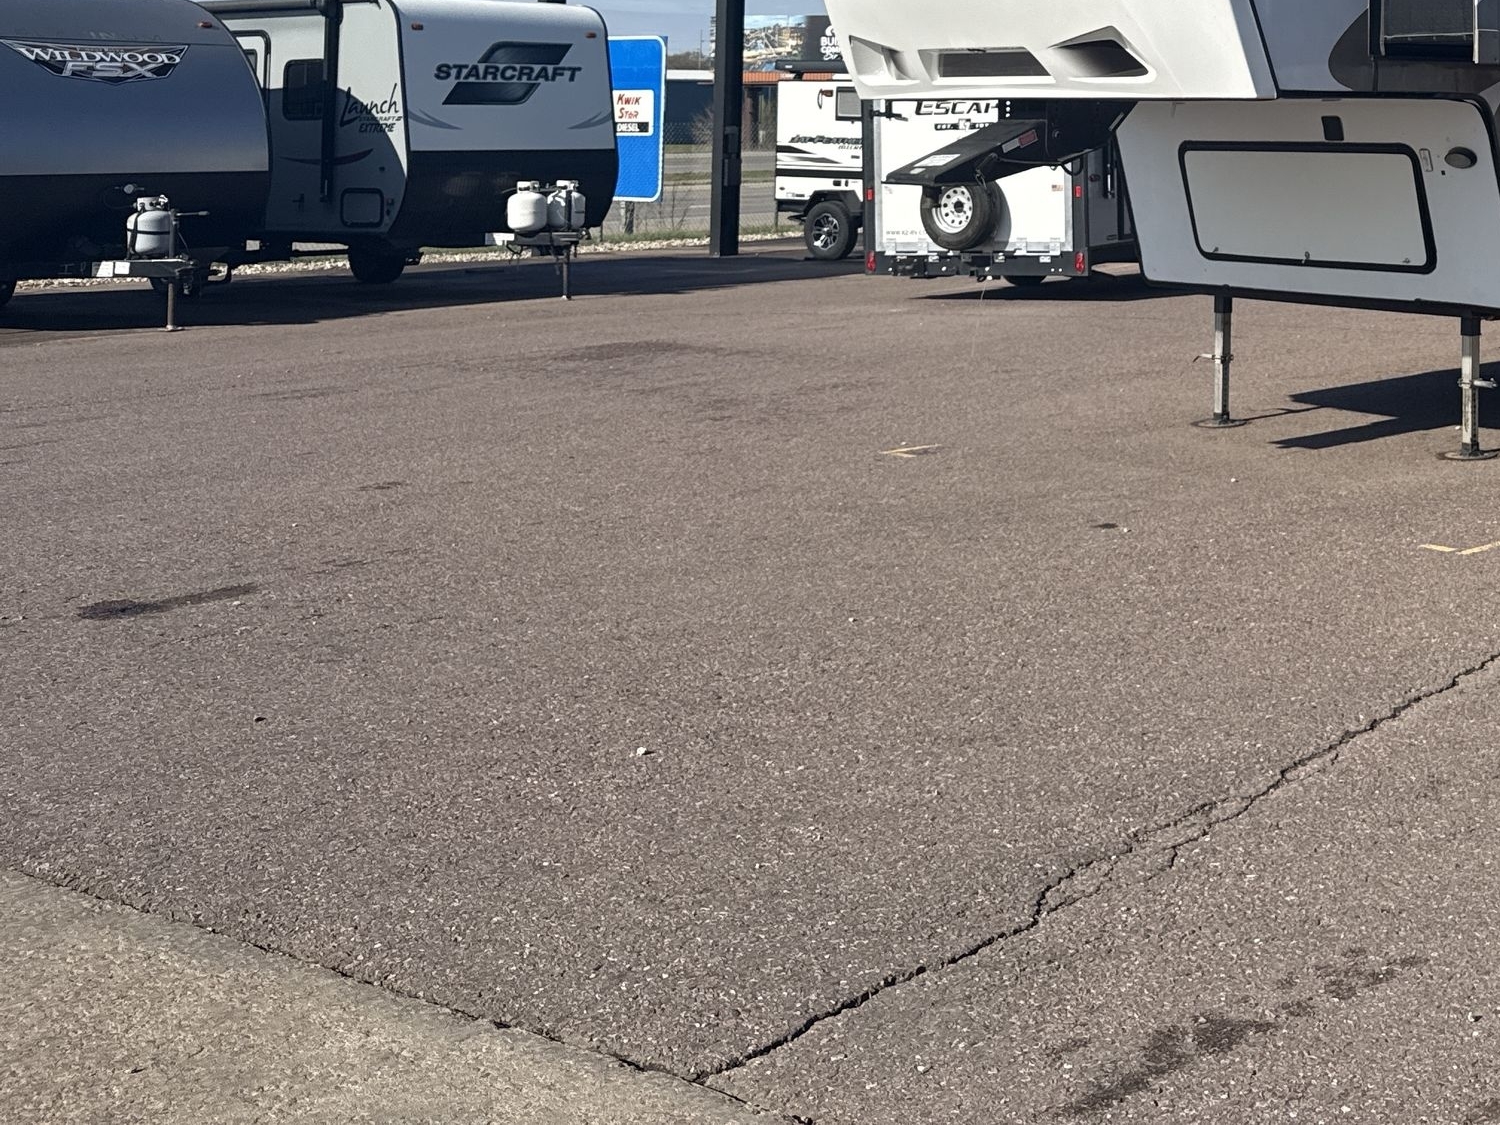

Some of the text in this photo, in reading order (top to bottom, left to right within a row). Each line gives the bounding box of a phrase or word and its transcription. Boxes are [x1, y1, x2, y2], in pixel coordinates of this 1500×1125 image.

[17, 47, 181, 64] WILDWOOD
[62, 61, 164, 78] FSX
[434, 63, 582, 82] STARCRAFT
[340, 83, 399, 127] Launch
[617, 94, 642, 105] KWIK
[359, 123, 396, 133] EXTREME
[617, 123, 640, 132] DIESEL
